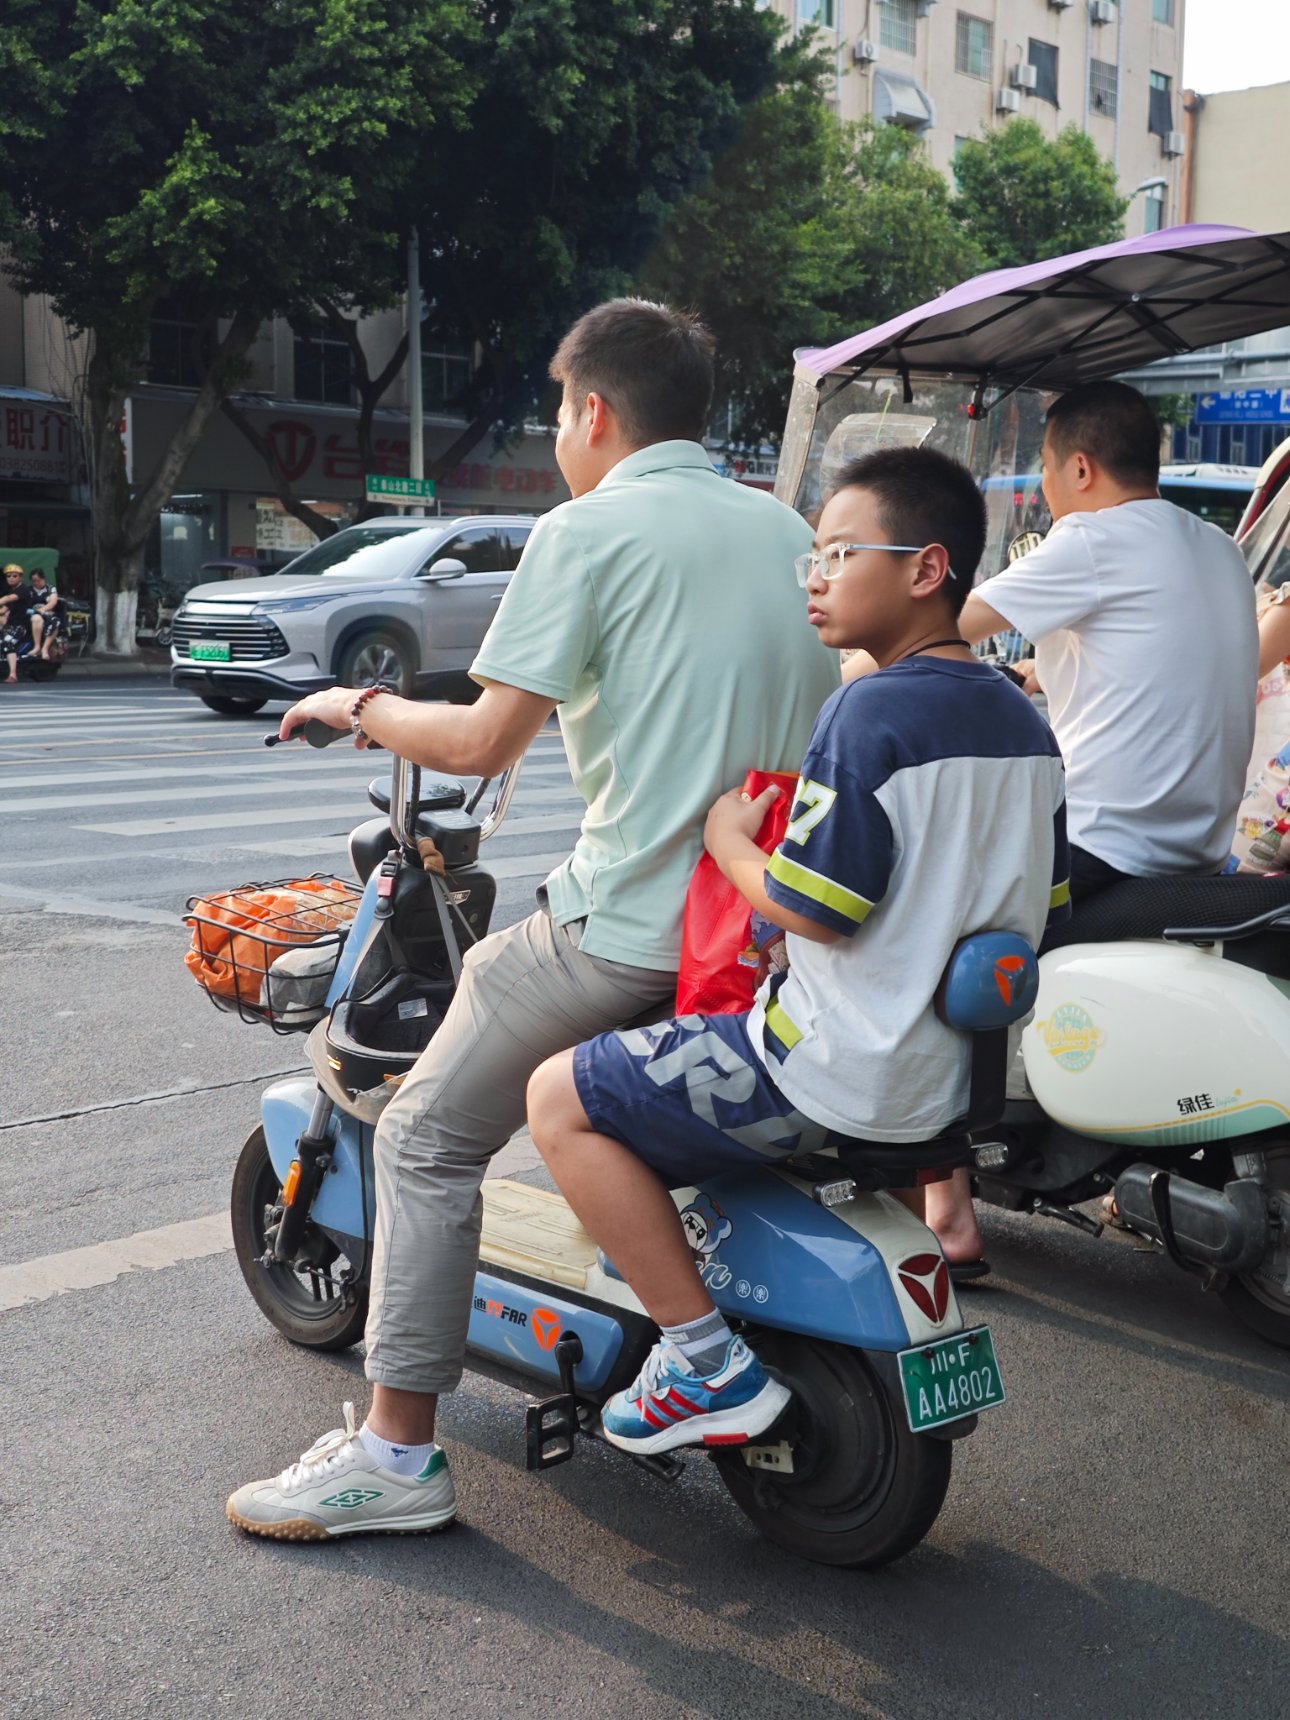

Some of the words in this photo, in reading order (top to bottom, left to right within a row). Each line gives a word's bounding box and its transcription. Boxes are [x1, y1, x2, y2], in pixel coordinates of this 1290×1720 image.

[0, 407, 69, 453] 职介
[1177, 1093, 1215, 1115] 绿佳
[919, 1366, 996, 1420] AA4802
